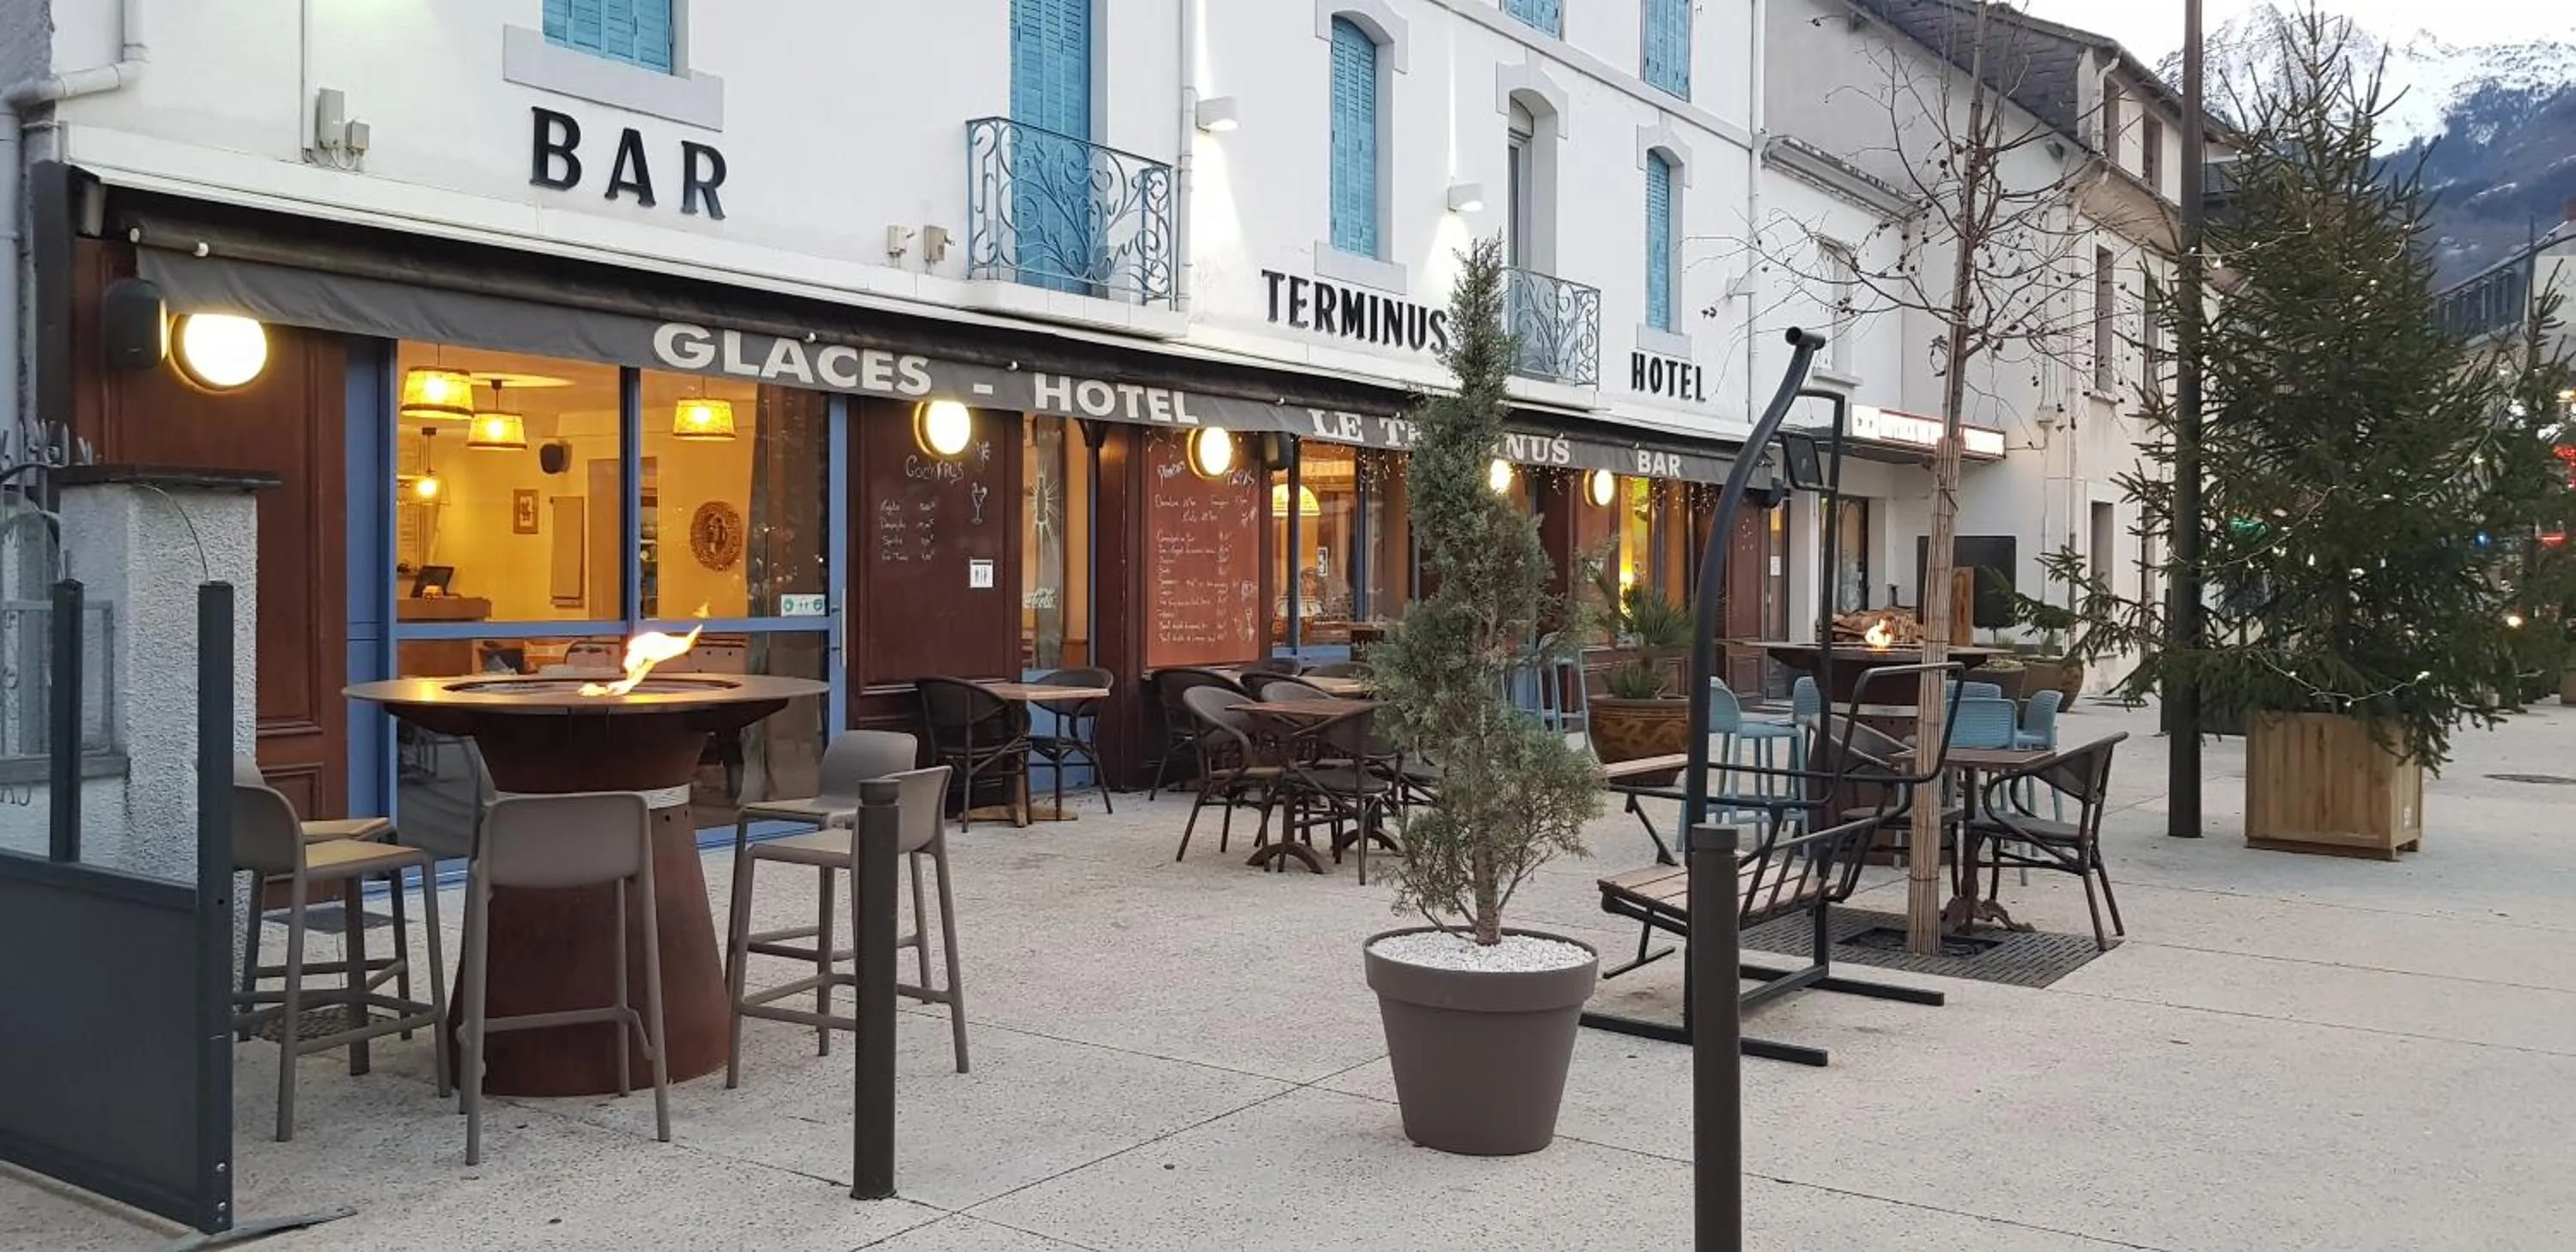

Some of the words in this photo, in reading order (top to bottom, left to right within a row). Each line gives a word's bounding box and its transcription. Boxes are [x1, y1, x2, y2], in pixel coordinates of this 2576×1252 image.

[530, 106, 727, 220] BAR
[1261, 268, 1449, 356] TERMINUS
[653, 322, 933, 396] GLACES
[1035, 372, 1200, 425] HOTEL
[1631, 351, 1706, 403] HOTEL
[1307, 408, 1364, 443] LE
[1637, 449, 1681, 479] BAR
